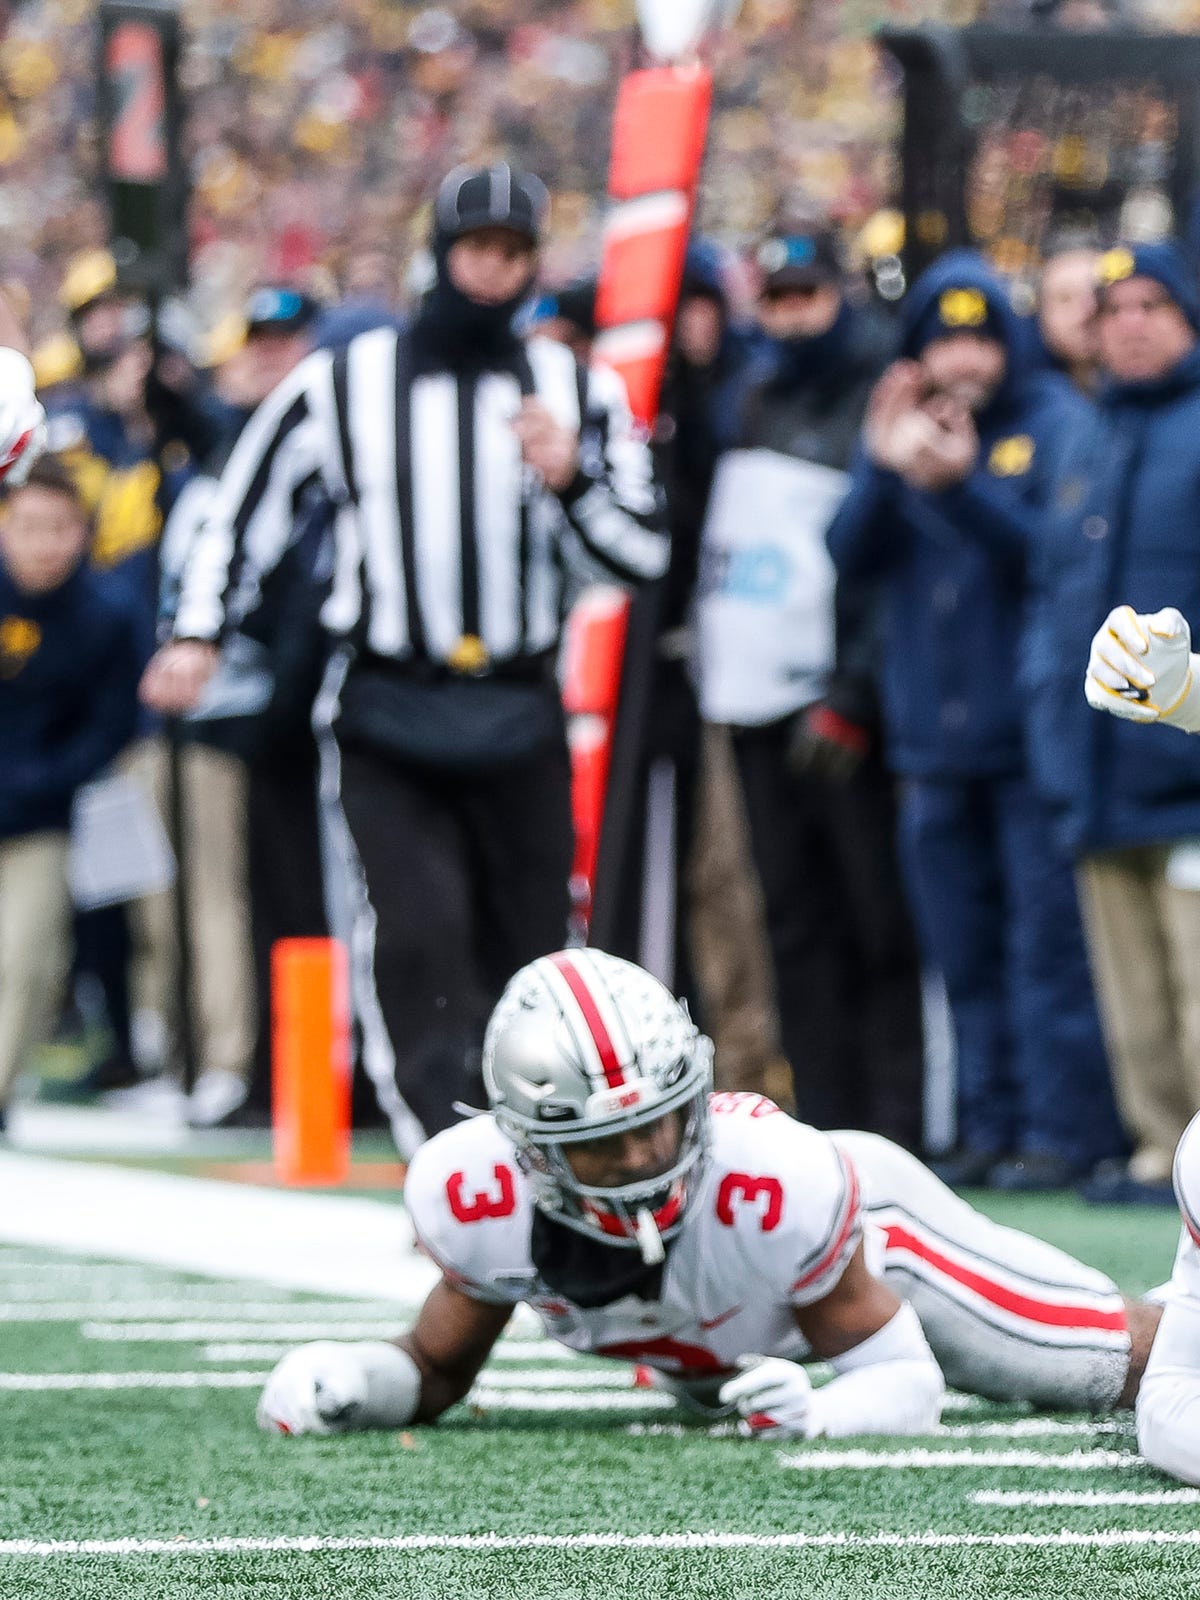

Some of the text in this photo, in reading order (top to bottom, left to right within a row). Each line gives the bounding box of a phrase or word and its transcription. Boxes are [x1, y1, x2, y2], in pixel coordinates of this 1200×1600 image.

[105, 22, 167, 178] 2
[446, 1164, 514, 1223] 3
[715, 1172, 783, 1232] 3
